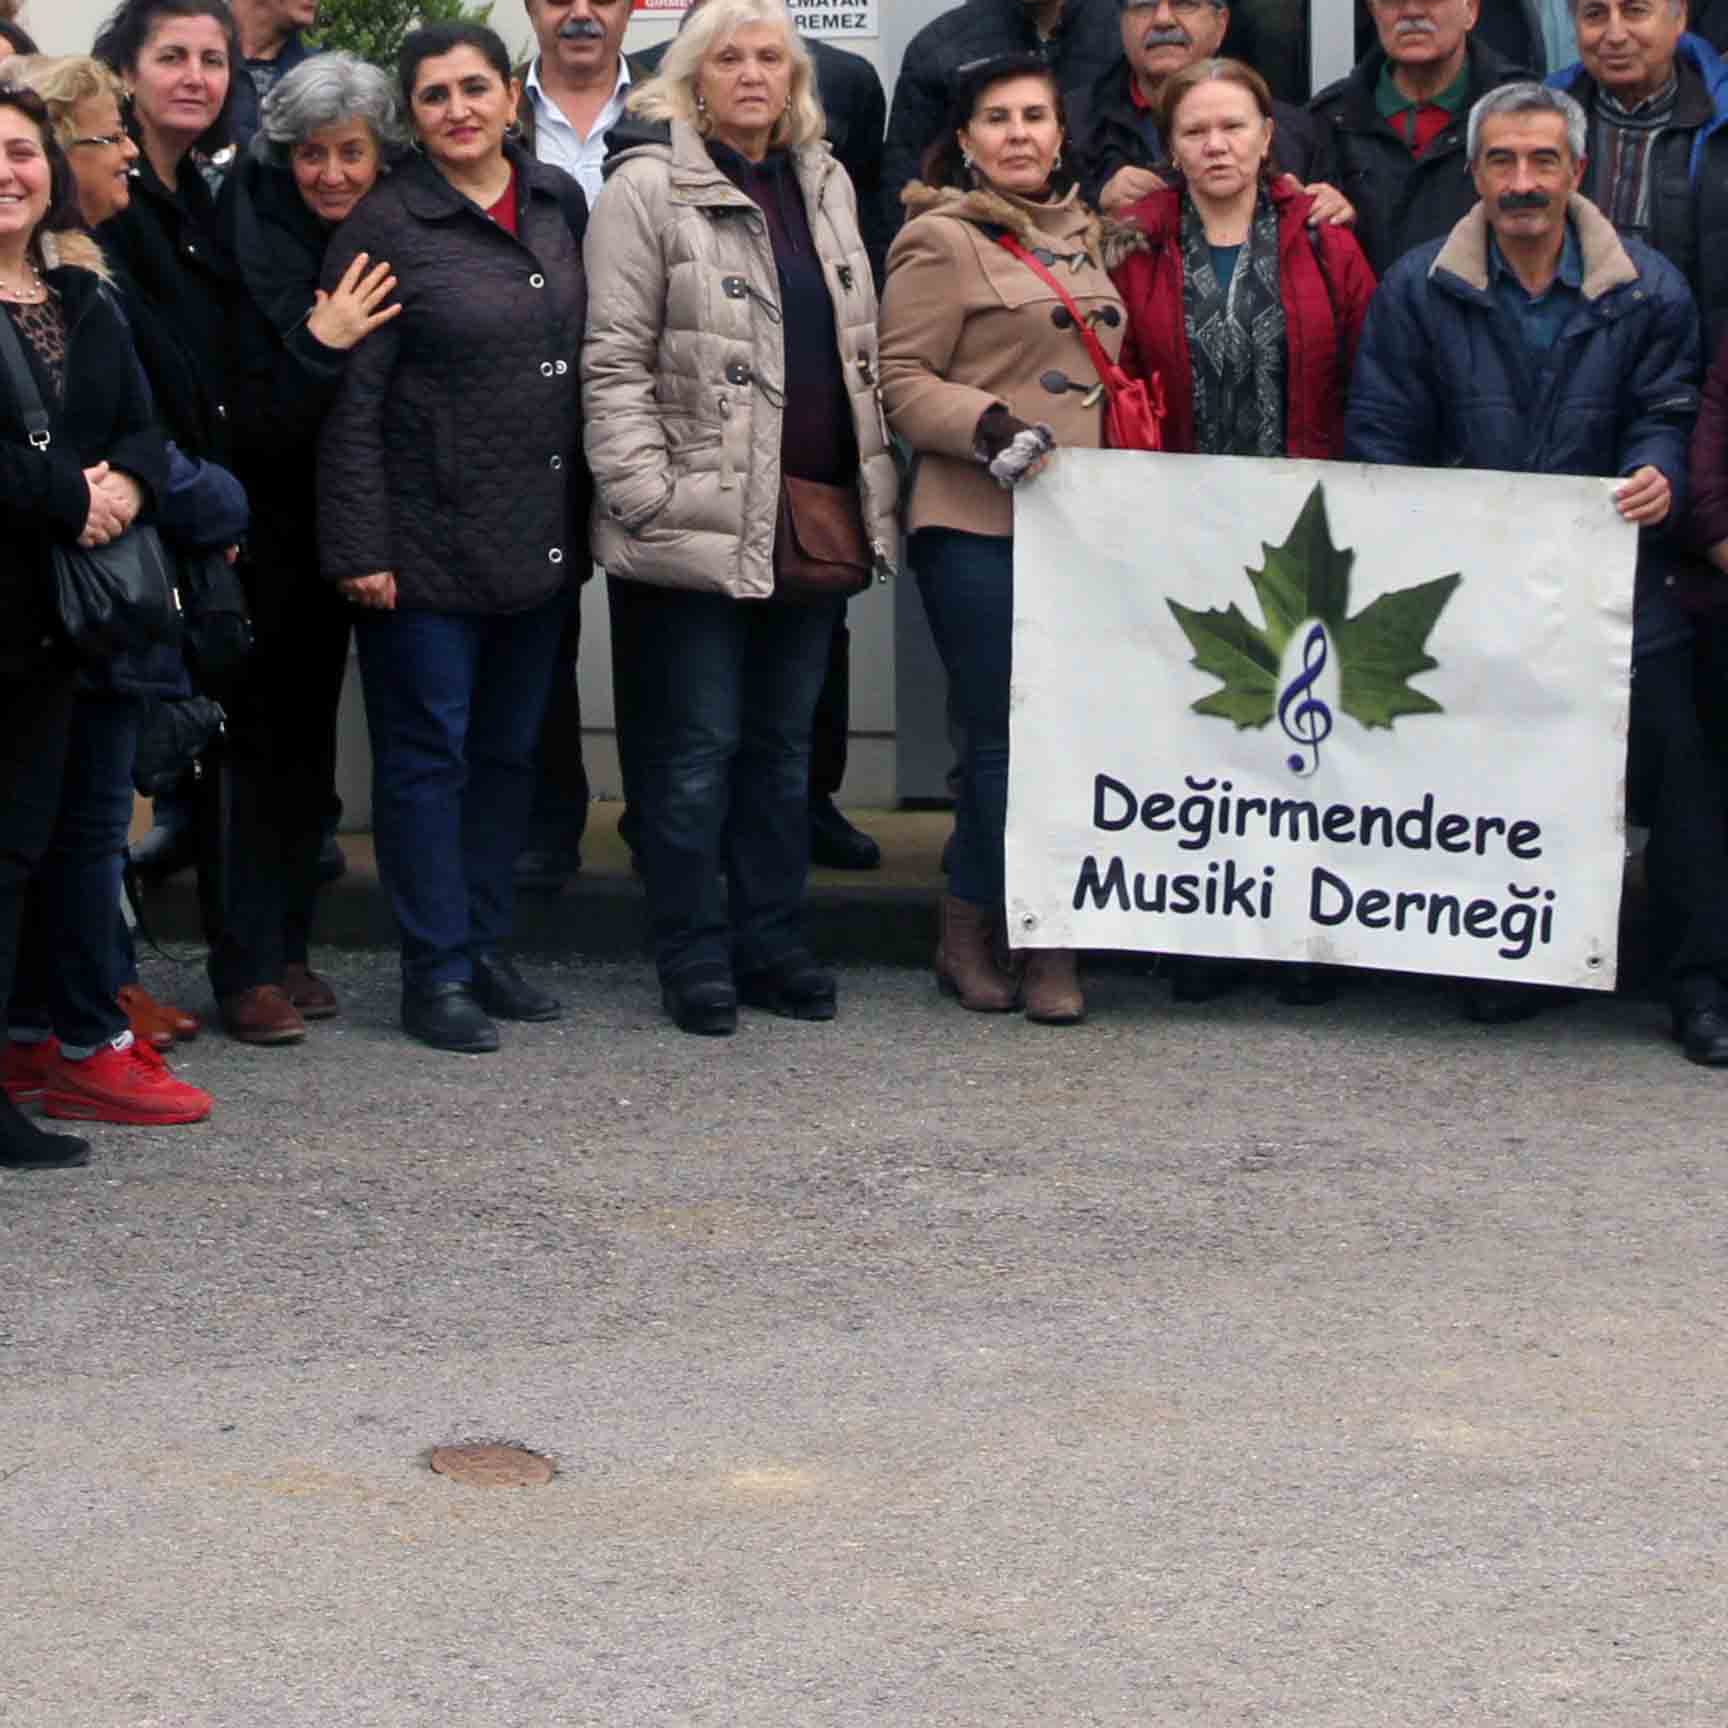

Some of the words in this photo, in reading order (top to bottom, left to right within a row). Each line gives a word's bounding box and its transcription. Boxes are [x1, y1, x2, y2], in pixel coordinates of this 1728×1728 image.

[793, 13, 867, 30] REMEZ
[1092, 773, 1543, 859] Değirmendere
[1072, 855, 1274, 919] Musiki
[1309, 866, 1557, 959] Derneği
